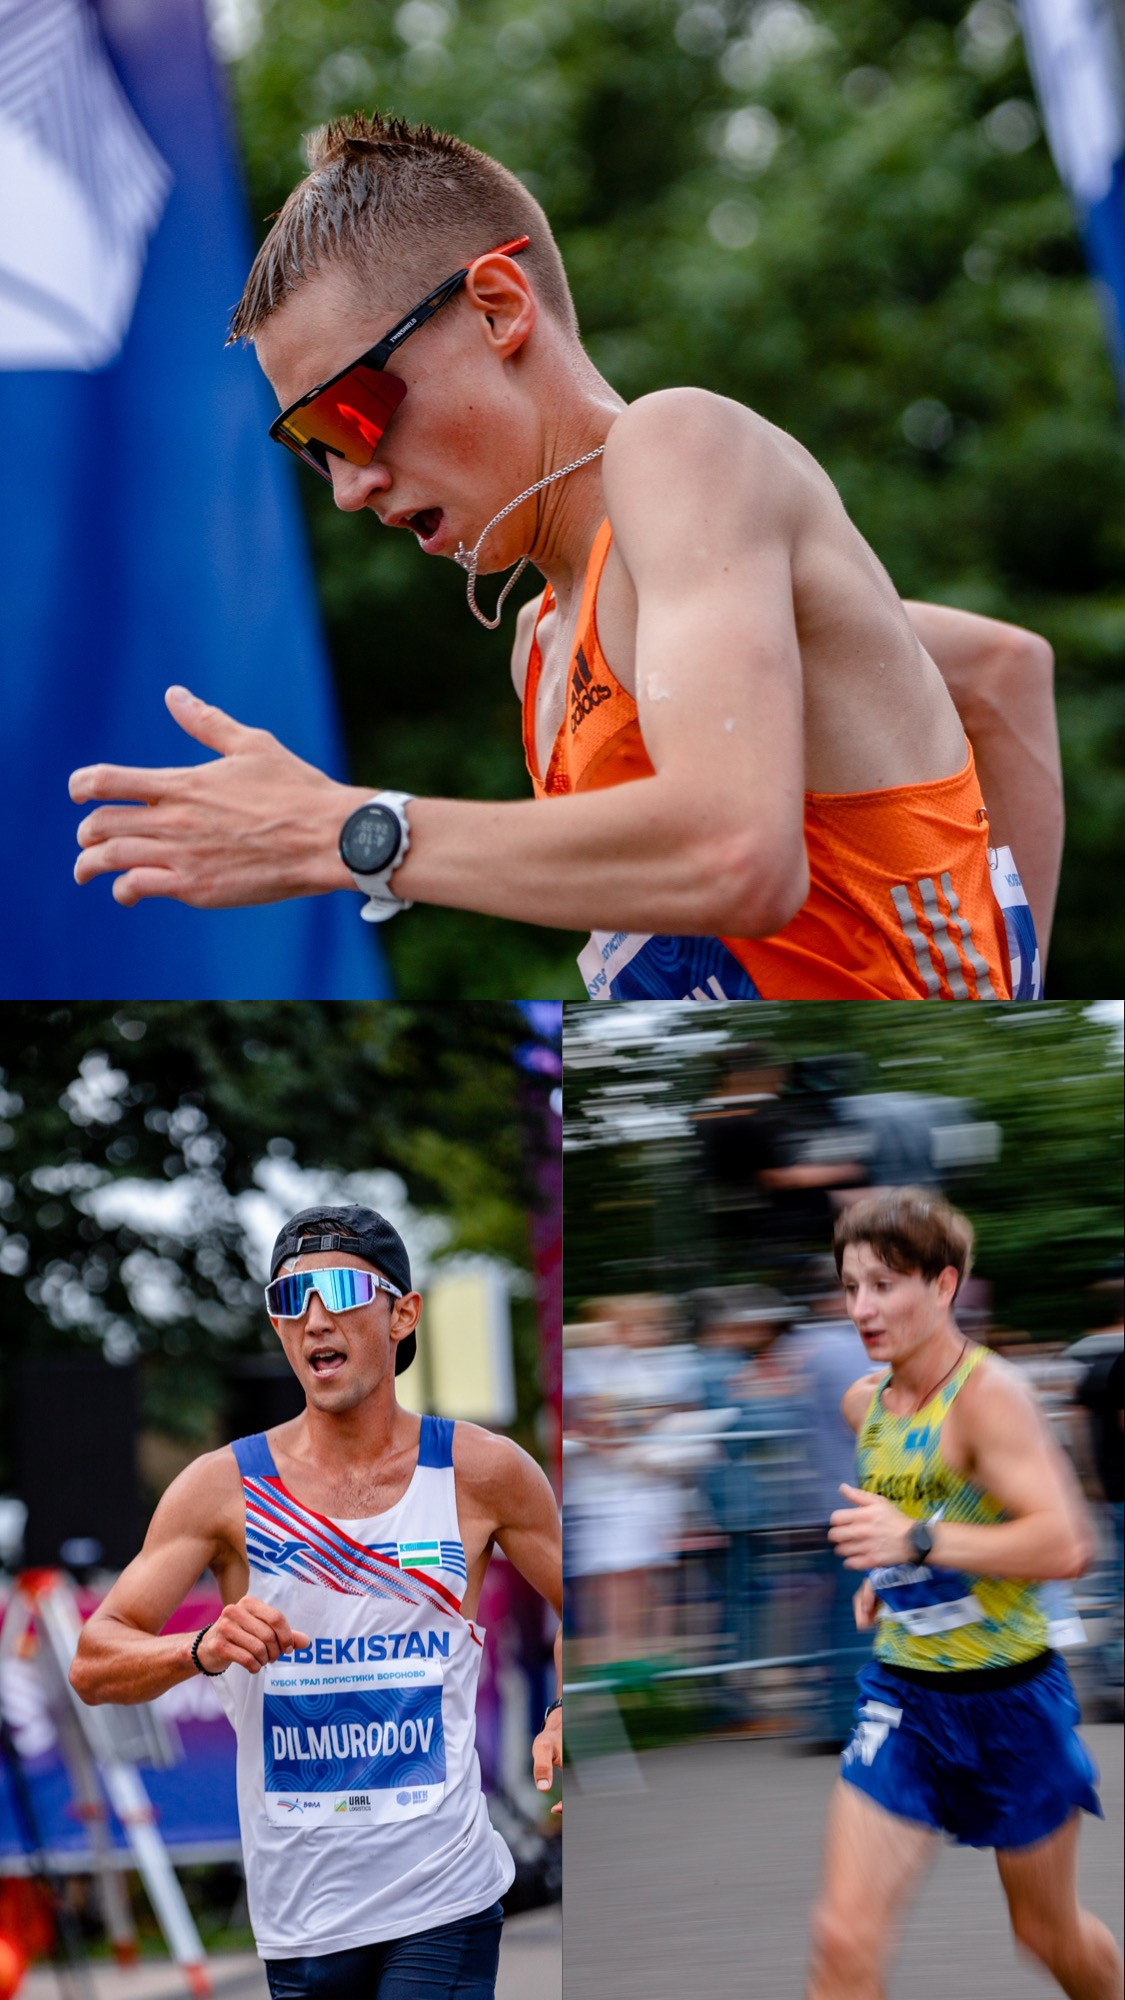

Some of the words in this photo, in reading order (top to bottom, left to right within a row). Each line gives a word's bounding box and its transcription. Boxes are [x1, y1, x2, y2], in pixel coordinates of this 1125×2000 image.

[276, 1631, 450, 1665] BEKISTAN
[270, 1679, 297, 1687] КУБОК
[299, 1677, 321, 1687] УРАЛ
[322, 1674, 374, 1686] ЛОГИСТИКИ
[377, 1670, 426, 1681] ВОРОНОВО
[271, 1717, 434, 1761] DILMURODOV
[348, 1795, 371, 1806] URAL
